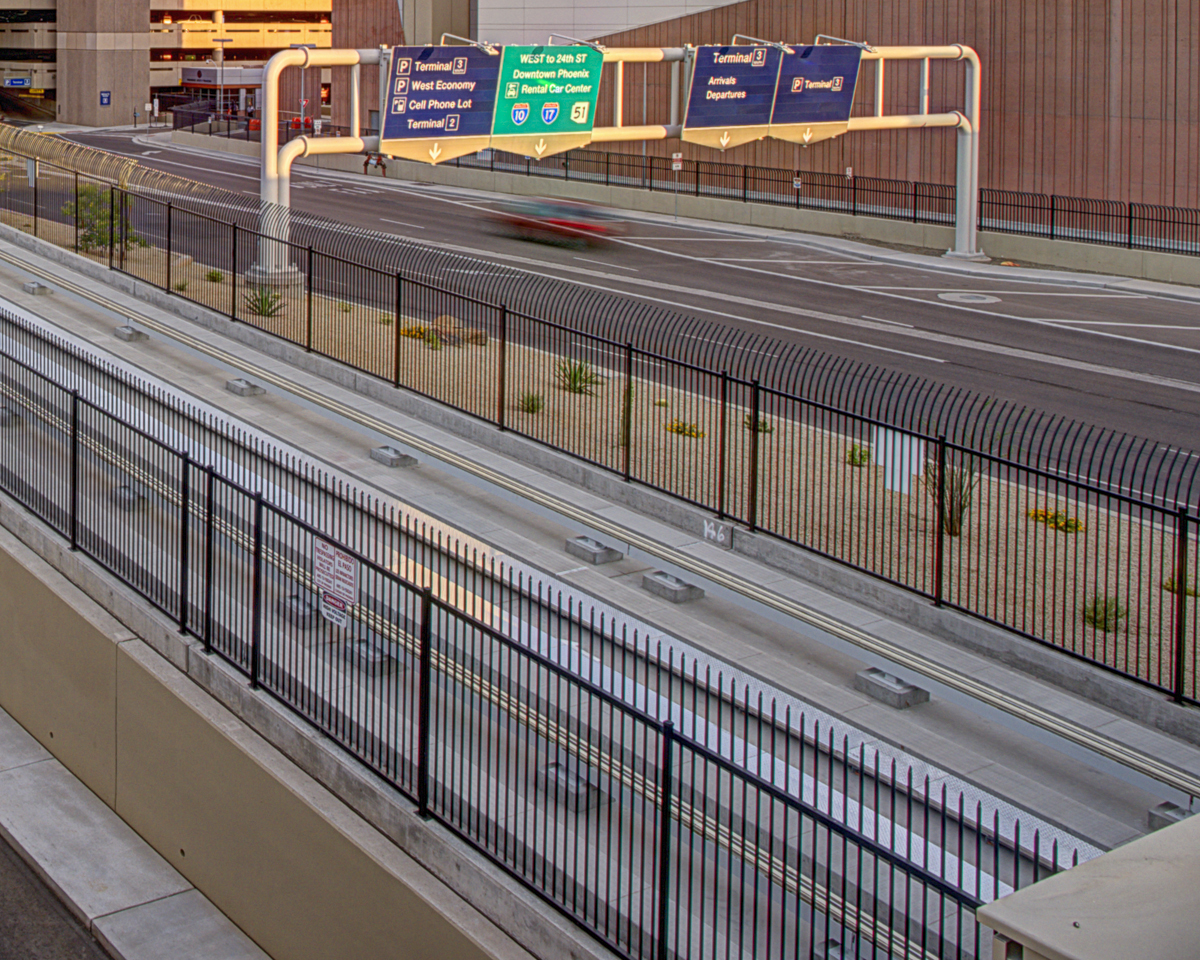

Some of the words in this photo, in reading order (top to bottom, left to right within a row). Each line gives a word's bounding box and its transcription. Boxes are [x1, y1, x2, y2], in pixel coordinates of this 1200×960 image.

[520, 54, 545, 63] WEST
[546, 55, 555, 63] to
[556, 54, 574, 63] 24th
[576, 54, 588, 63] ST
[713, 52, 753, 63] Terminal
[756, 51, 763, 60] 3
[400, 61, 408, 72] P
[415, 61, 452, 71] Terminal
[457, 60, 463, 68] 3
[513, 70, 556, 79] Downtown
[558, 69, 590, 78] Phoenix
[397, 80, 406, 92] P
[412, 81, 434, 90] West
[436, 80, 476, 92] Economy
[708, 76, 737, 85] Arrivals
[794, 80, 801, 89] P
[805, 80, 832, 89] Terminal
[521, 84, 548, 93] Rental
[549, 84, 564, 93] Car
[565, 84, 592, 93] Center
[706, 90, 746, 101] Departures
[409, 100, 426, 110] Cell
[428, 100, 456, 109] Phone
[457, 99, 472, 108] Lot
[515, 110, 525, 121] 10
[545, 110, 555, 120] 17
[573, 107, 585, 119] 51
[407, 119, 445, 129] Terminal
[449, 119, 455, 127] 2
[325, 595, 343, 607] DANGER
[332, 608, 346, 619] VOLTAGE
